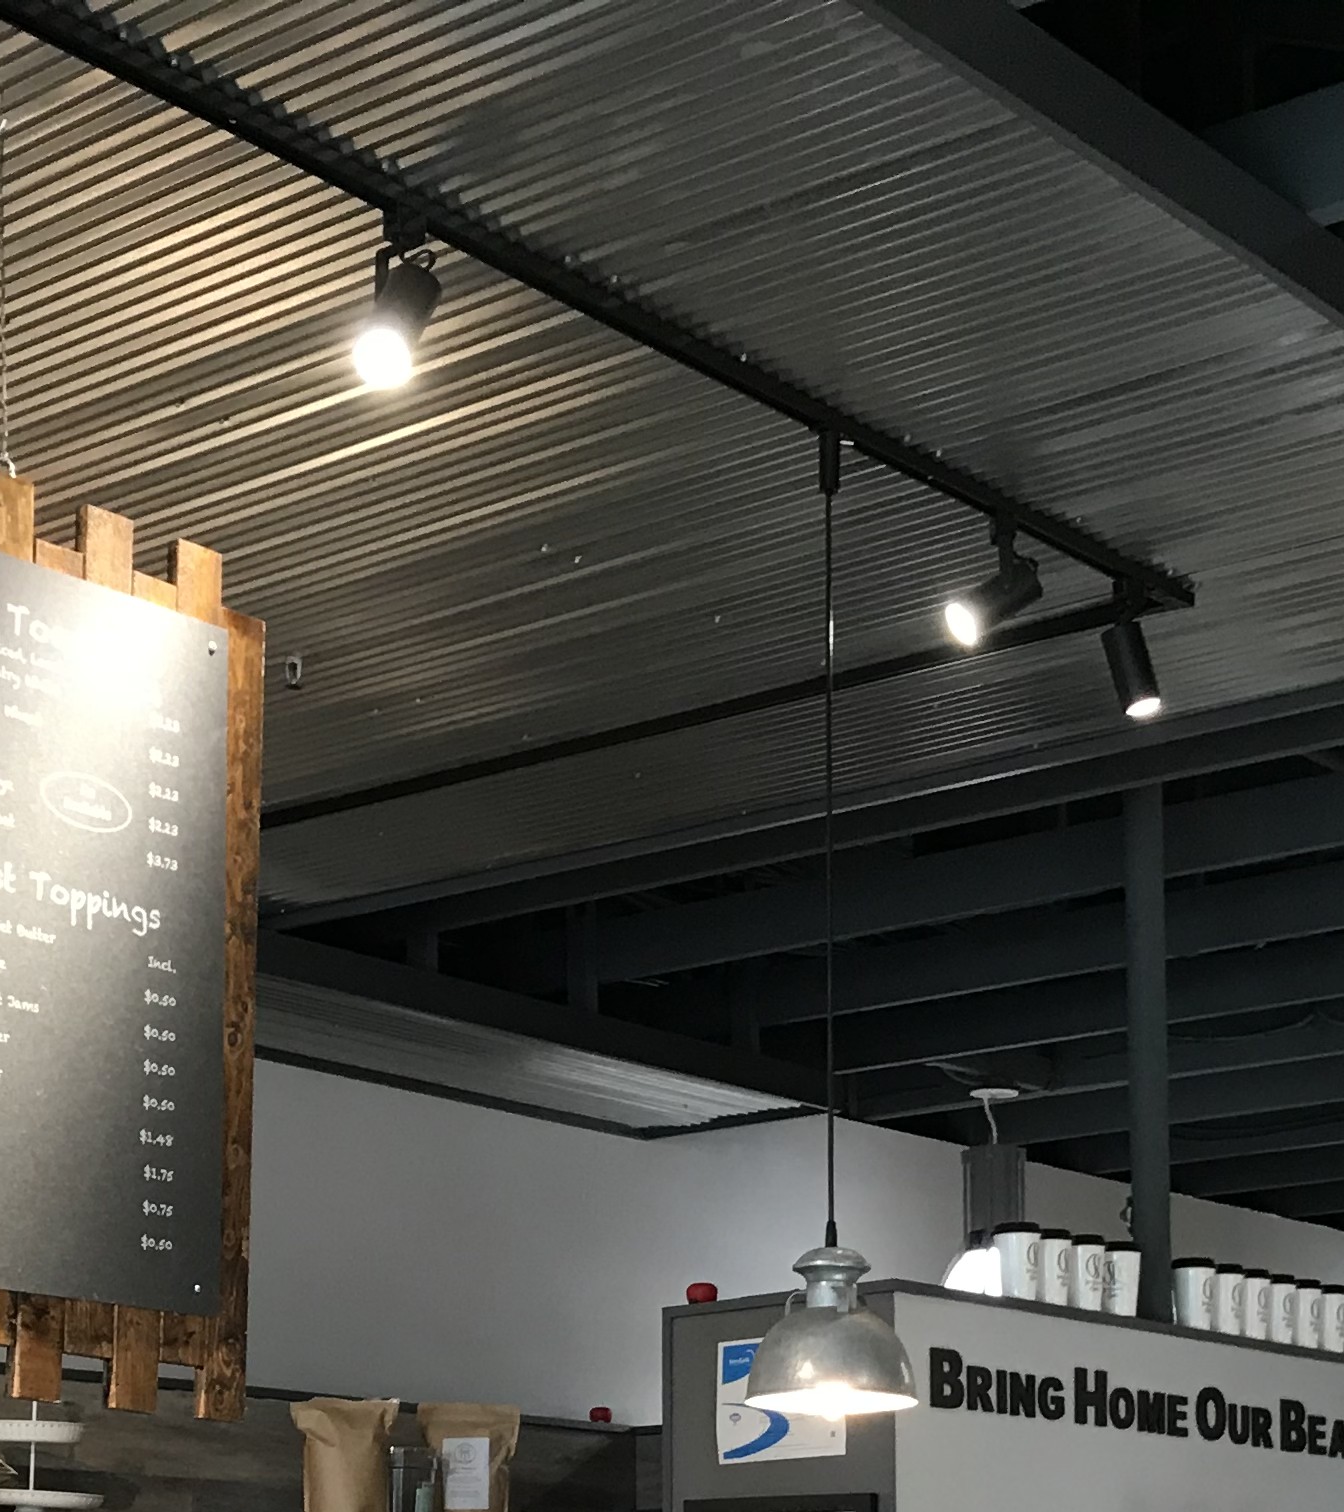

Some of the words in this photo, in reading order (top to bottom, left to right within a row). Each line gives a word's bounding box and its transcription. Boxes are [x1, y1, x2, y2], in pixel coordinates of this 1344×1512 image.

[30, 869, 161, 936] Toppings
[7, 995, 40, 1014] Jams
[929, 1346, 1065, 1422] BRING
[1075, 1368, 1189, 1438] HOME
[1196, 1387, 1274, 1449] OUR
